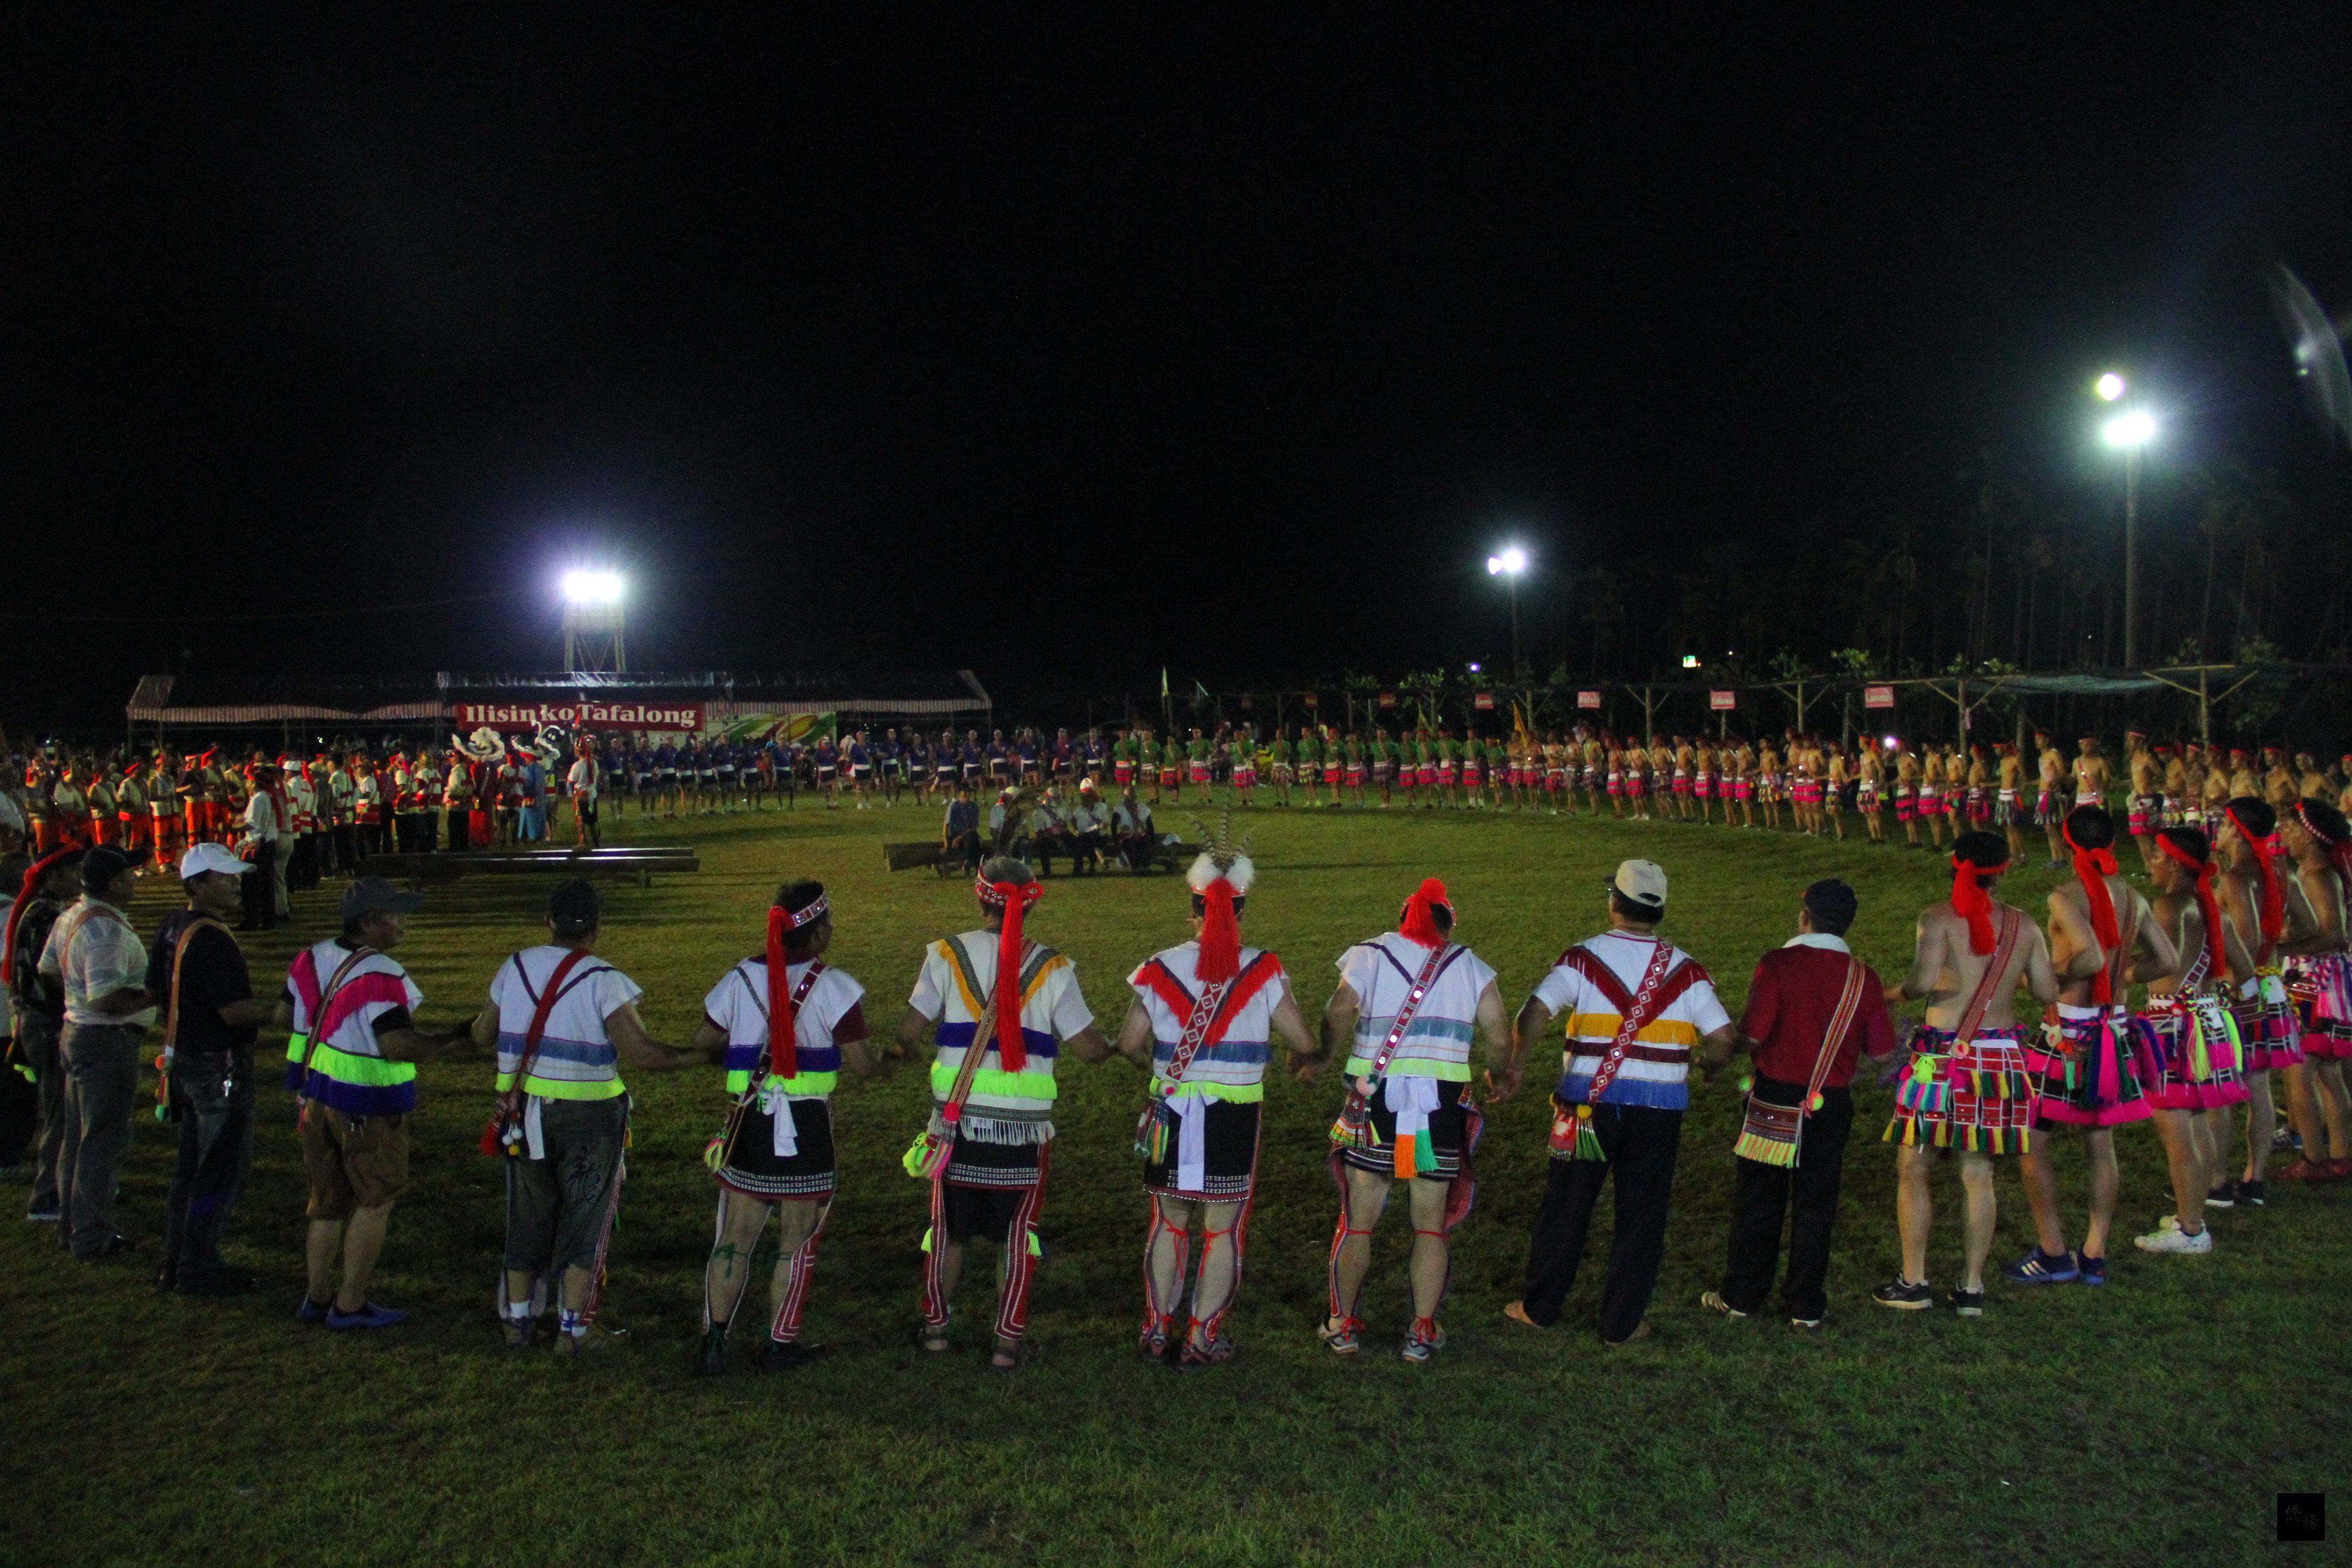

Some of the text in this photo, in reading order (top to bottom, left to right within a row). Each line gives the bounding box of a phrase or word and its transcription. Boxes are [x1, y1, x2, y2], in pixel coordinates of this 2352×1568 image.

[466, 705, 536, 722] Ilisin
[540, 704, 574, 721] ko
[576, 704, 696, 728] Tafalong
